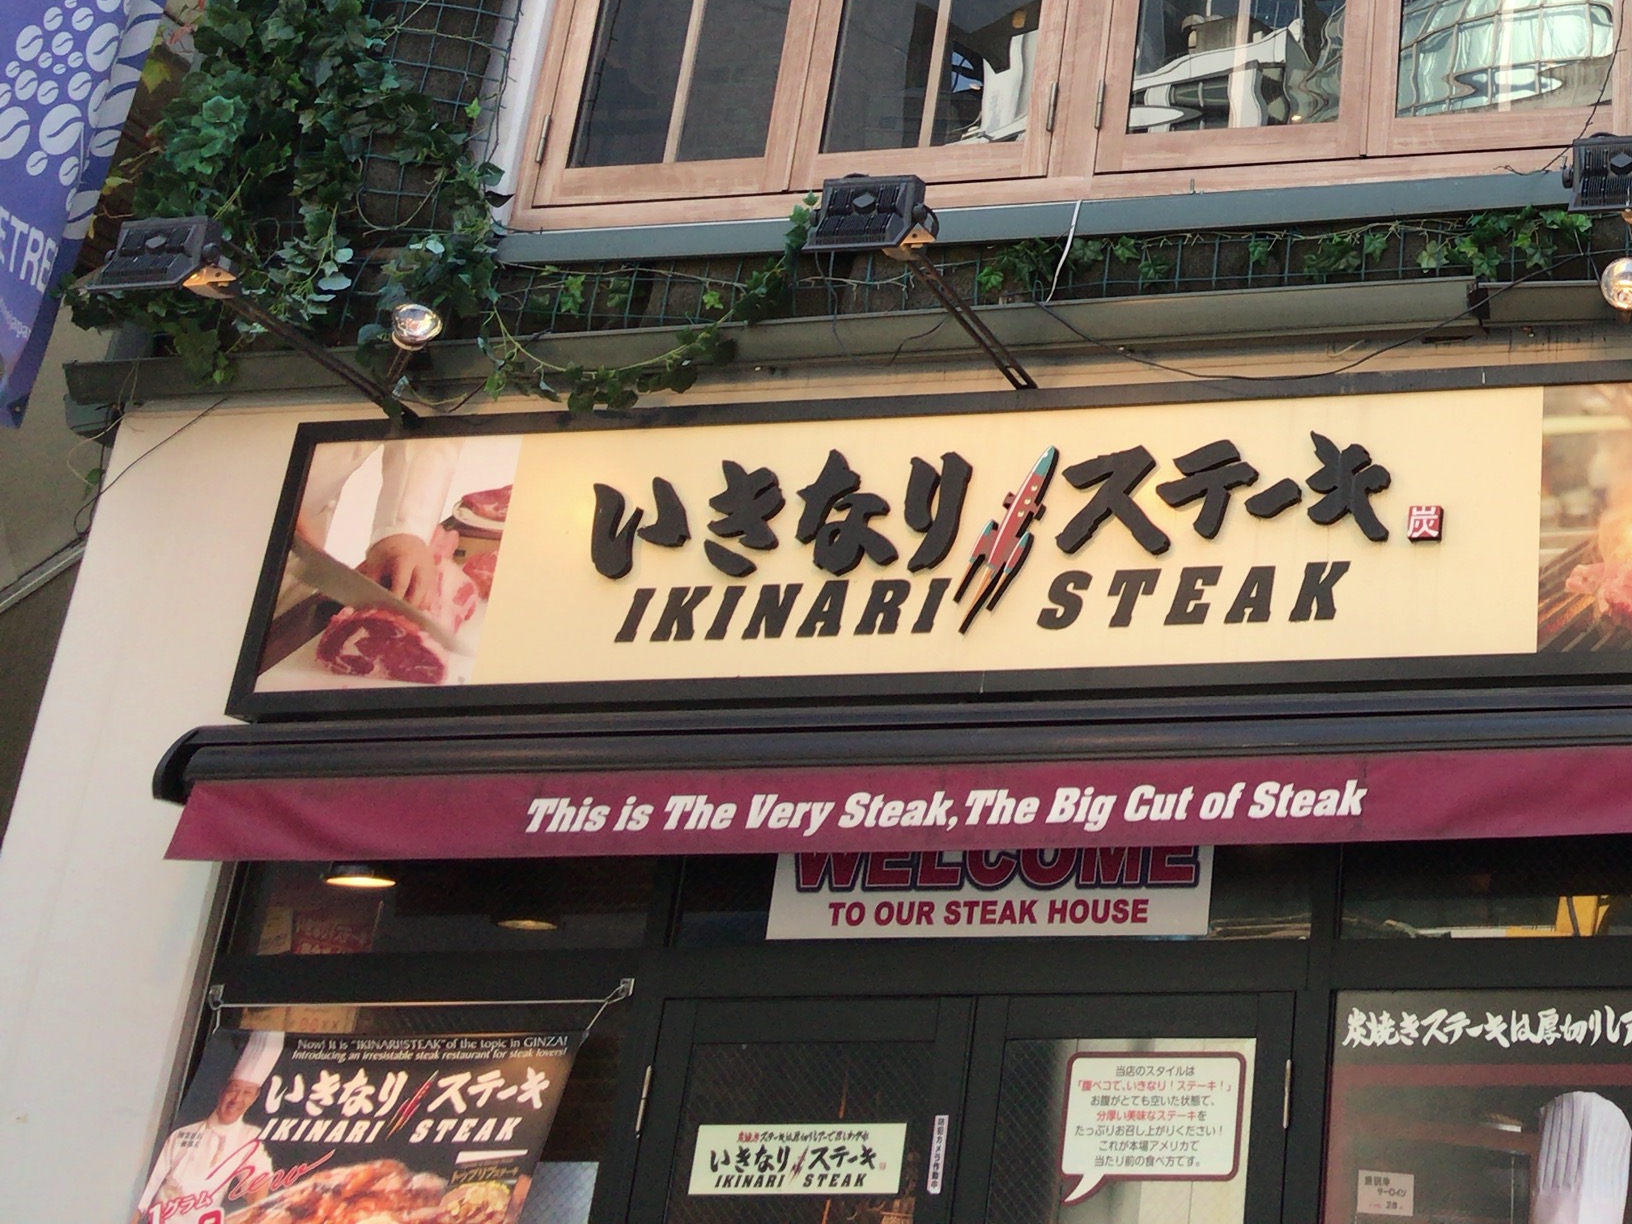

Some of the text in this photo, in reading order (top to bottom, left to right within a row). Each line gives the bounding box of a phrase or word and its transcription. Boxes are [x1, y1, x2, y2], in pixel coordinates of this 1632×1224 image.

[592, 430, 1392, 579] いきなり ステーキ
[1406, 505, 1444, 543] 炭
[614, 560, 1351, 644] IKINARI STEAK
[525, 779, 1369, 837] This is The Very Steak, The Big Cut of Steak
[828, 898, 1150, 927] TO OUR STEAK HOUSE
[460, 1038, 477, 1049] the
[480, 1038, 507, 1053] topic
[510, 1038, 521, 1048] in
[523, 1036, 569, 1048] GINZA!
[1115, 1065, 1195, 1077] 当店のスタイルは
[264, 1066, 551, 1118] いきなり ステーキ
[1096, 1110, 1207, 1121] 分厚い美味なステーキを
[257, 1116, 523, 1144] IKINARI STEAK
[709, 1144, 878, 1173] いきなり ステーキ
[1098, 1140, 1200, 1152] これが本場アメリカで
[1094, 1155, 1201, 1167] 当たり前の食べ方です。
[714, 1173, 867, 1189] IKINARI STEAK
